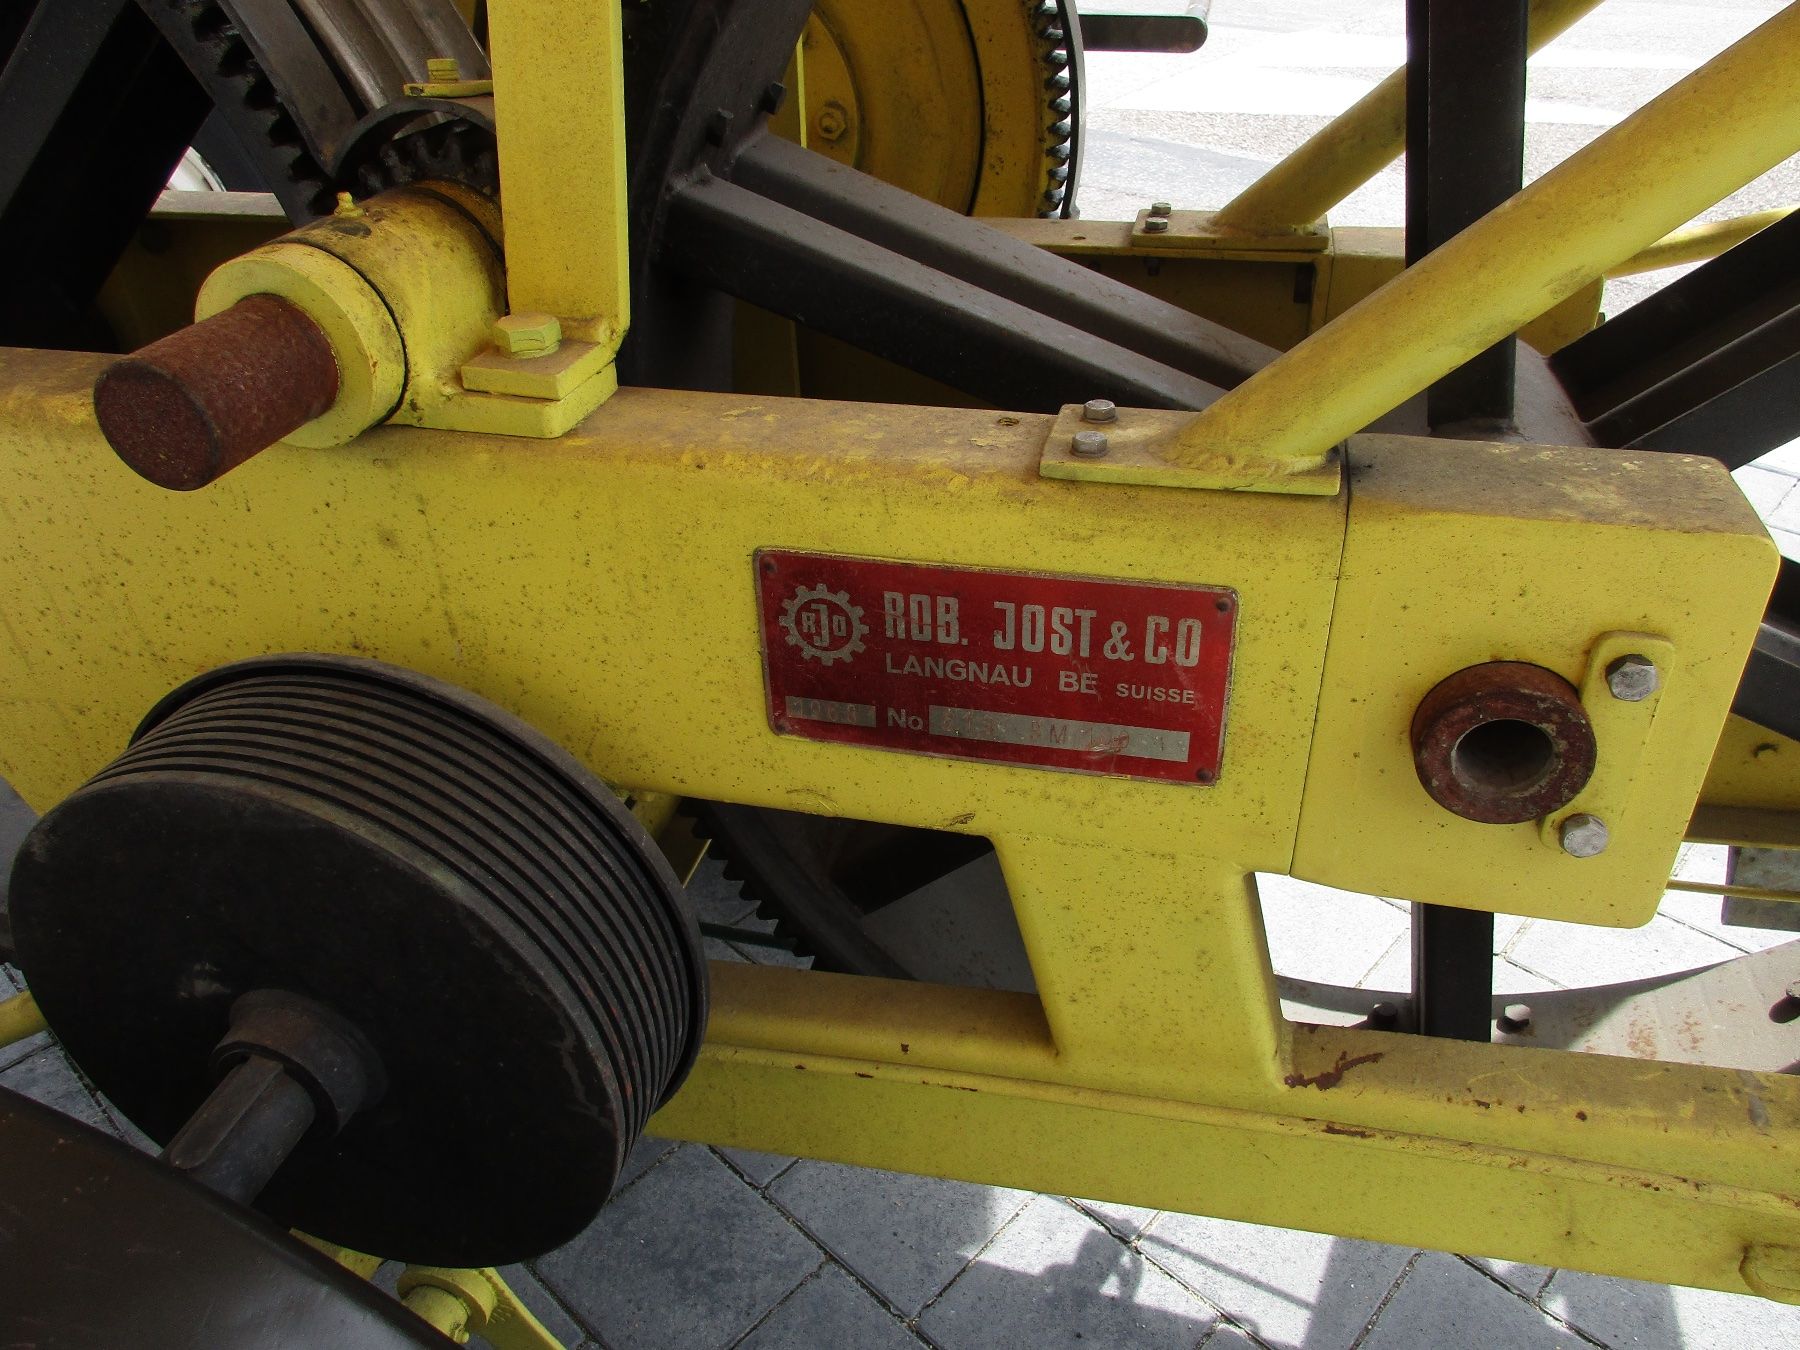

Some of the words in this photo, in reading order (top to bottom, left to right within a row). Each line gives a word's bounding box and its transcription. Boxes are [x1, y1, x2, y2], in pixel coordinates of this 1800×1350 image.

[884, 591, 968, 646] ROB.
[993, 600, 1096, 658] JOST
[1103, 621, 1135, 661] &
[1144, 615, 1202, 667] CO
[886, 653, 1032, 688] LANGNAU
[1059, 670, 1098, 695] BE
[1116, 683, 1195, 704] SUISSE
[887, 708, 924, 732] No
